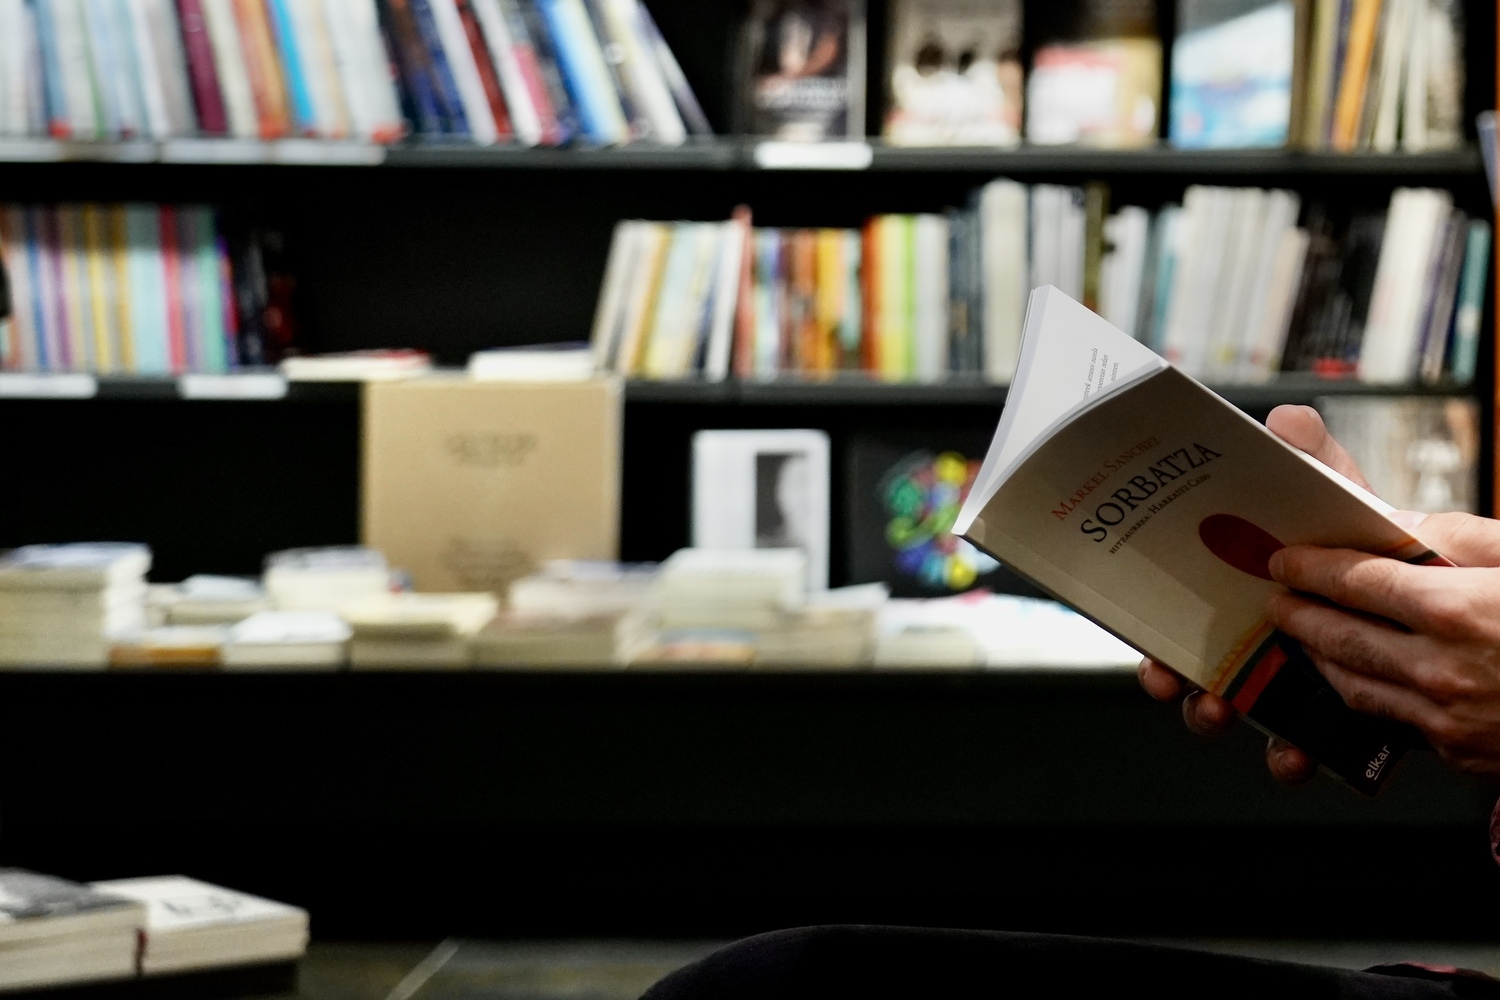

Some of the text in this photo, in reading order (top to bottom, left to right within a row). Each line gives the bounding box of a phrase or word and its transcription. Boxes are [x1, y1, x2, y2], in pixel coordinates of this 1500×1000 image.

[1051, 472, 1109, 520] MARKEL
[1080, 443, 1222, 543] SORBATZA
[1366, 745, 1390, 779] elkar
